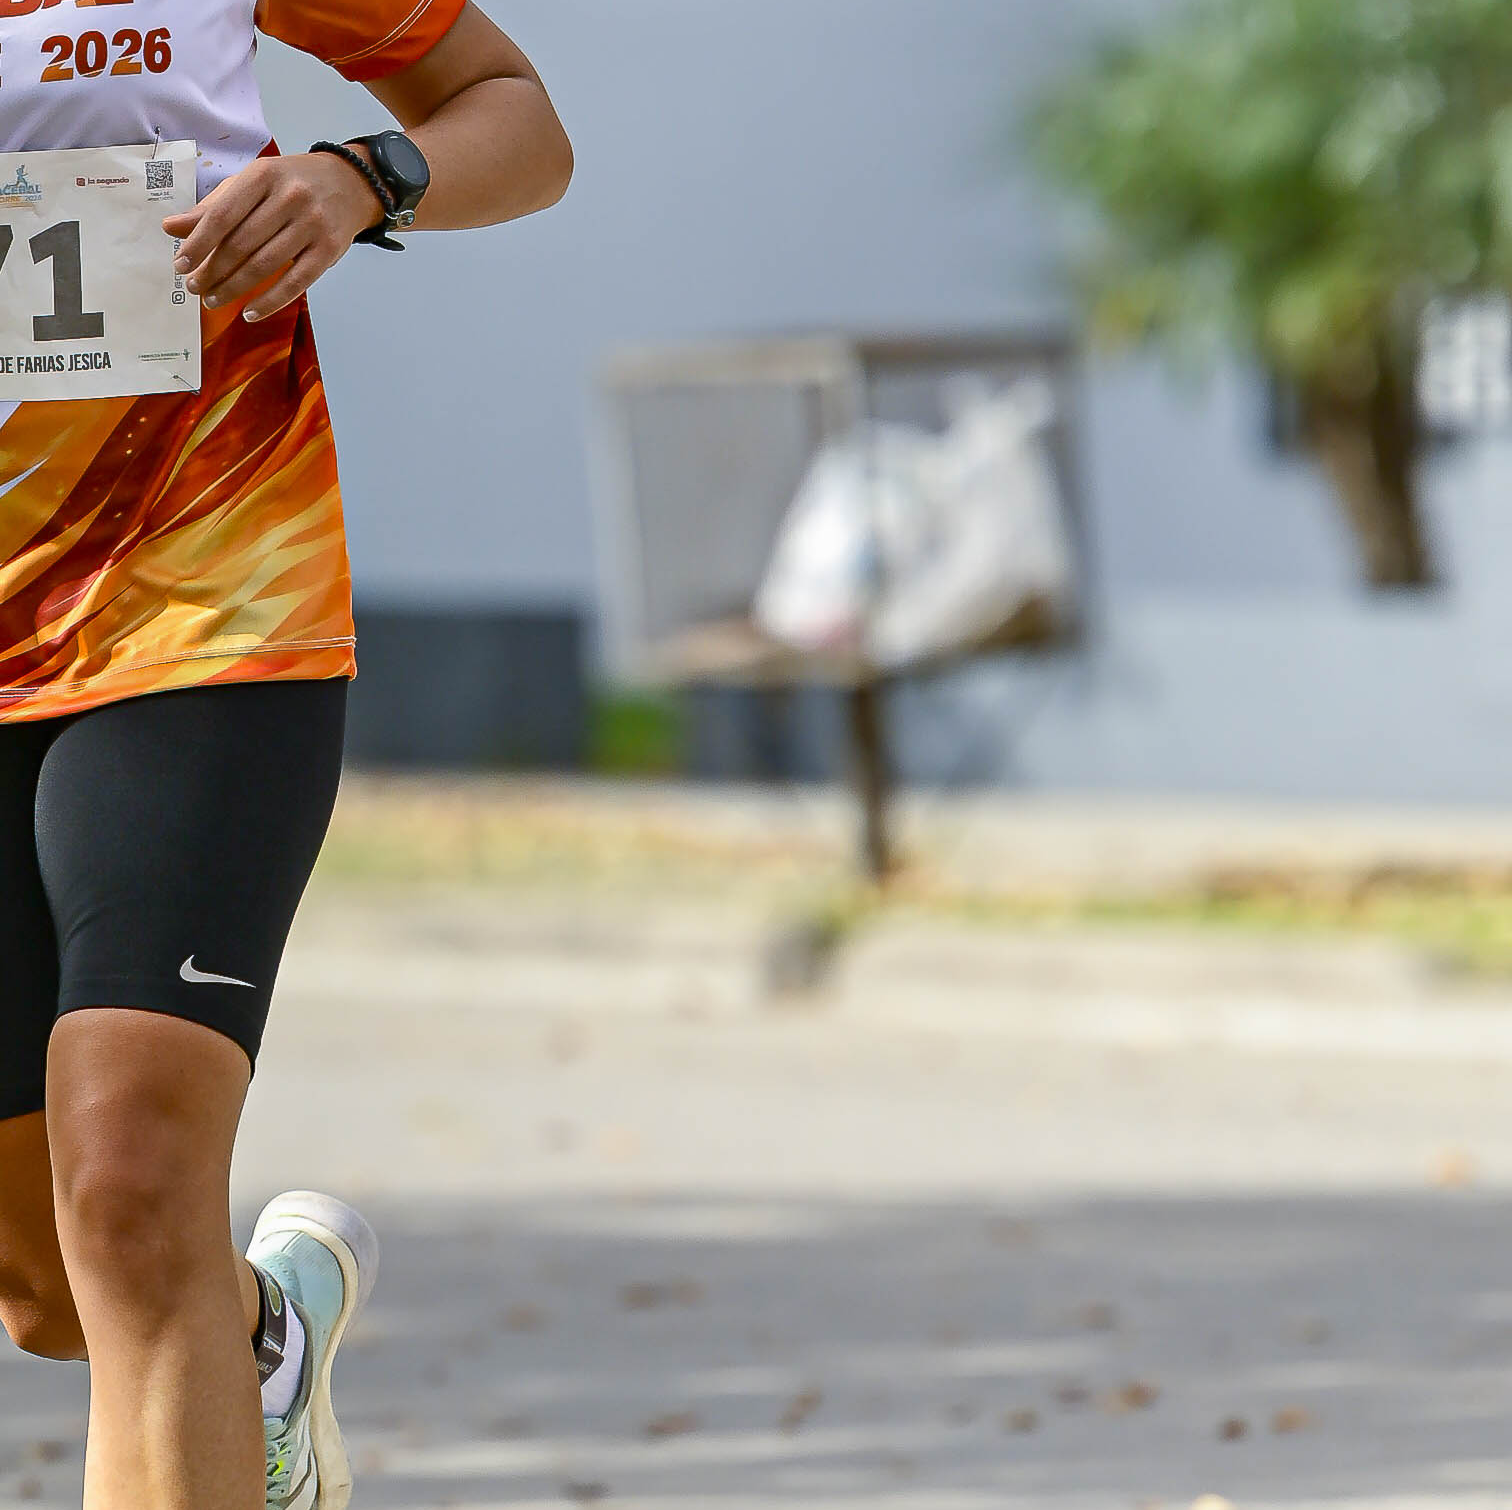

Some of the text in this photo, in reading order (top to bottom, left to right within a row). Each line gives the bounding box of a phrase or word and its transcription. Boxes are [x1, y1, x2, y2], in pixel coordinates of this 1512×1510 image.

[40, 26, 172, 83] 2026
[17, 354, 65, 374] FARIAS
[67, 351, 112, 372] JESICA
